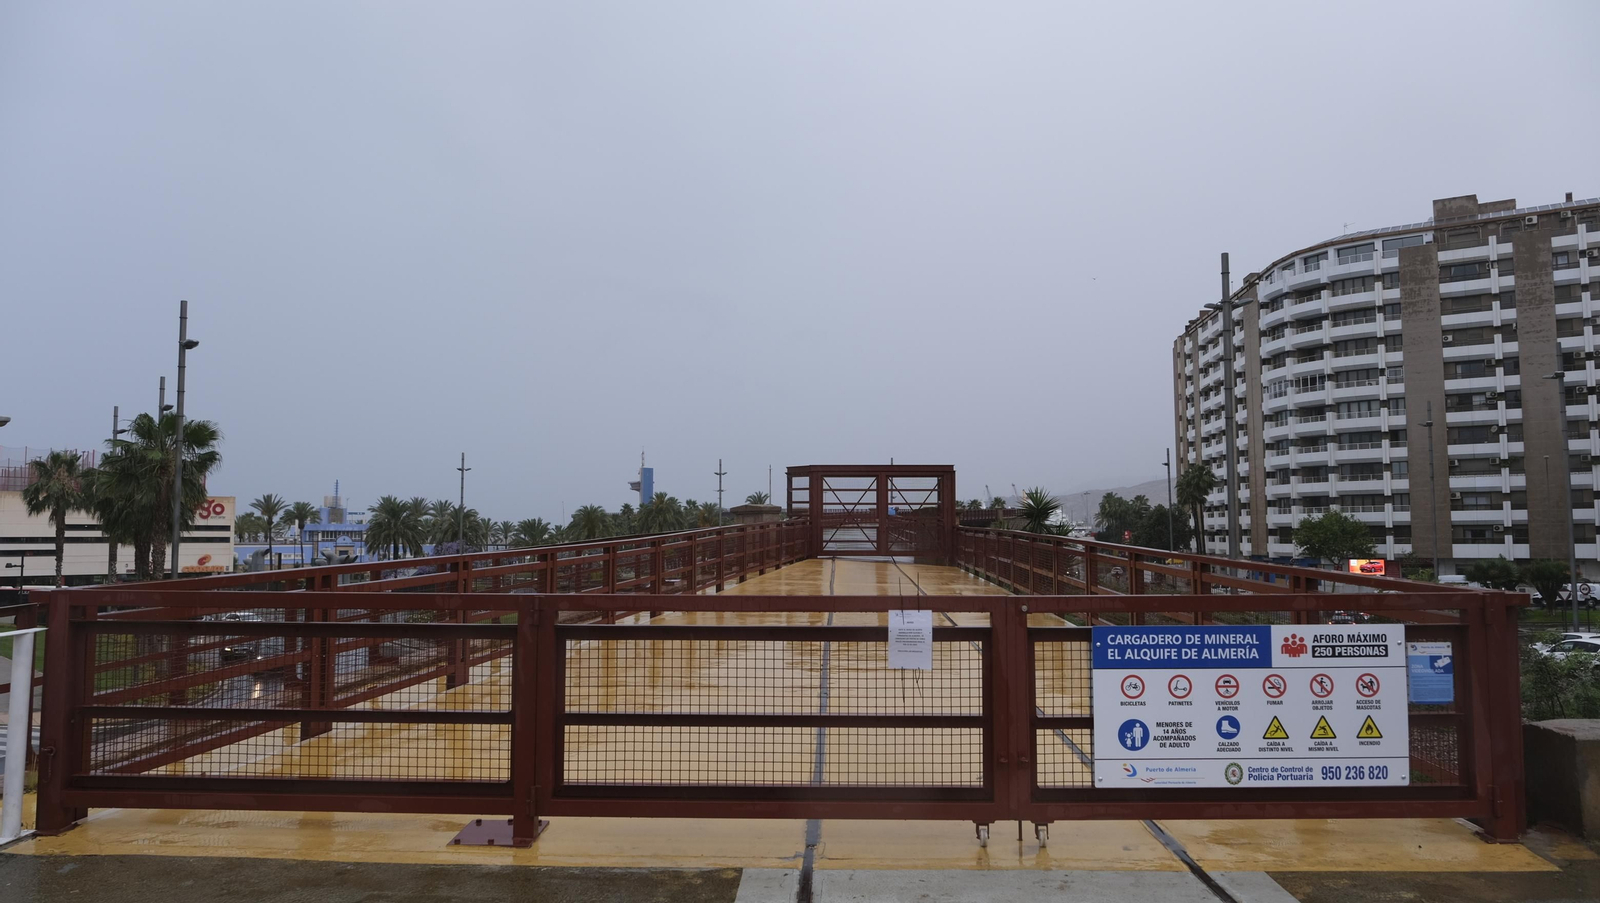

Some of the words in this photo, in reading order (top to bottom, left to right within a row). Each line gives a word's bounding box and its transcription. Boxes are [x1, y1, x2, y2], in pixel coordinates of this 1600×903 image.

[1107, 634, 1182, 645] CARGADERO
[1185, 634, 1201, 645] DE
[1204, 634, 1259, 645] MINERAL
[1312, 634, 1344, 644] AFORO
[1347, 632, 1387, 643] MÁXIMO
[1107, 648, 1121, 660] EL
[1124, 648, 1178, 661] ALQUIFE
[1181, 648, 1198, 659] DE
[1201, 645, 1259, 659] ALMERÍA
[1314, 647, 1333, 656] 250
[1335, 646, 1386, 656] PERSONAS
[1277, 772, 1314, 780] Portuaria
[1322, 766, 1342, 780] 950
[1345, 766, 1364, 780] 236
[1368, 766, 1388, 780] 820
